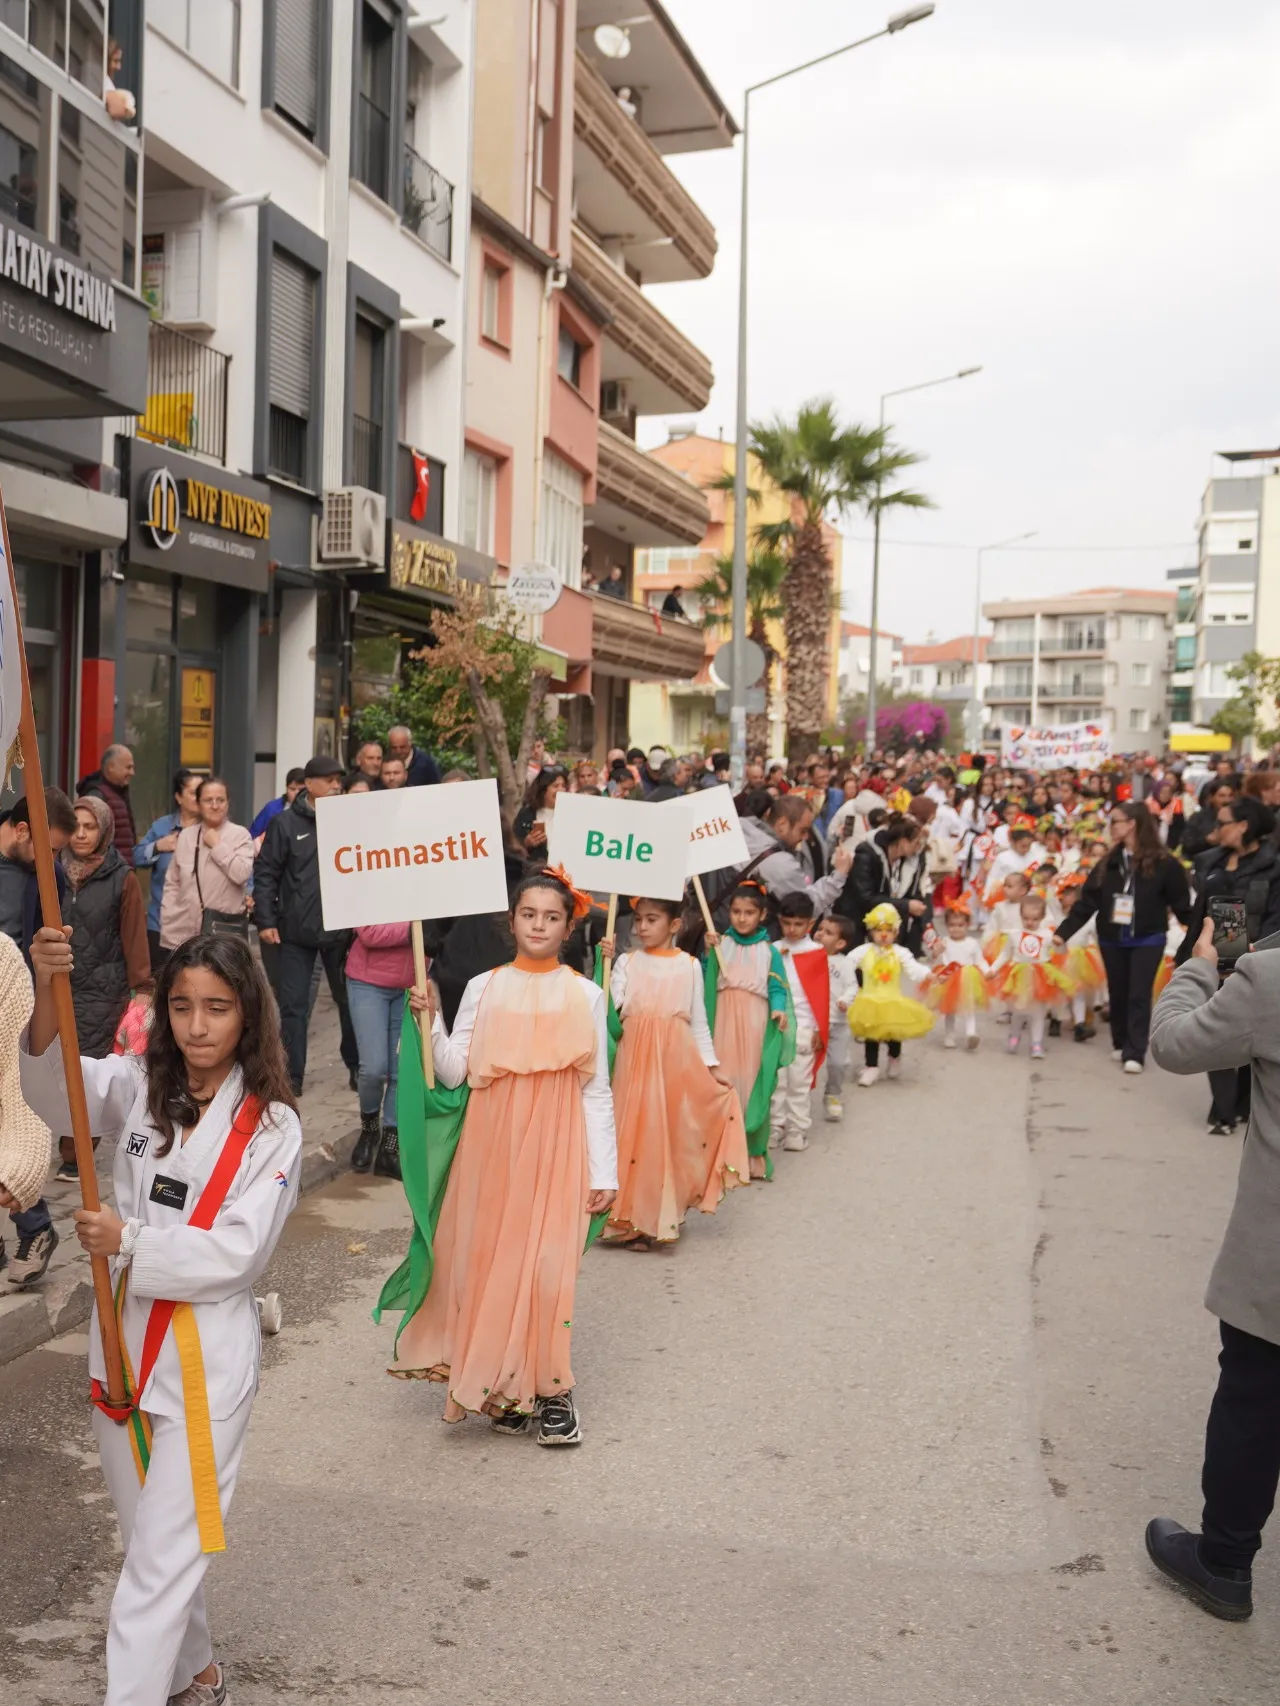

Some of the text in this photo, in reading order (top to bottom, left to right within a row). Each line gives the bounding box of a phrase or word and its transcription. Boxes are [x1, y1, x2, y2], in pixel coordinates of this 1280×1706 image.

[54, 257, 117, 333] STENNA
[28, 314, 95, 365] RESTAURANT
[220, 489, 272, 541] INVEST
[334, 831, 489, 874] Cimnastik
[585, 830, 653, 862] Bale
